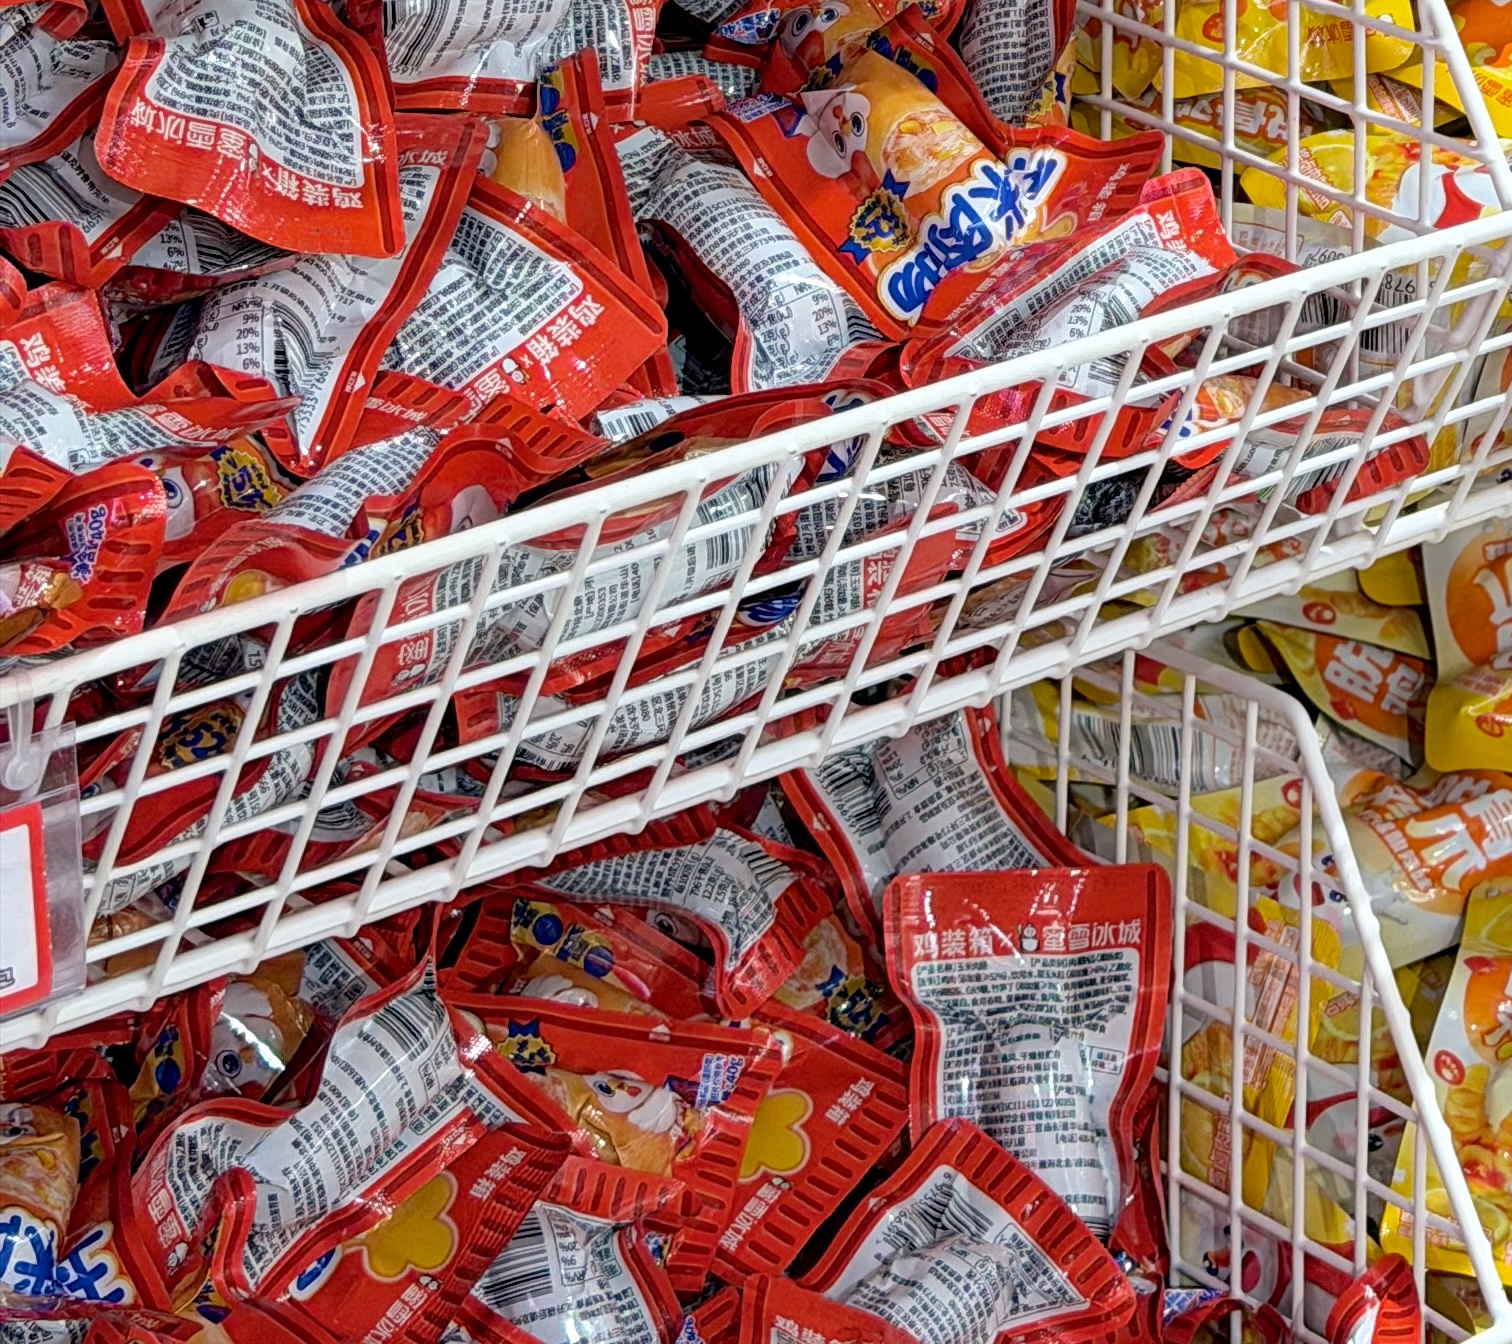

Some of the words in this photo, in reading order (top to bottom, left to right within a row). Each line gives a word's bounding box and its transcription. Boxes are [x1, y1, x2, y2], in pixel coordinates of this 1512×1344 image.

[812, 308, 833, 321] 20%
[1070, 302, 1091, 314] 20%
[817, 320, 837, 334] 13%
[236, 328, 260, 341] 20%
[236, 343, 260, 357] 13%
[242, 358, 261, 371] 6%
[912, 925, 994, 959] 鸡装箱
[1043, 919, 1142, 952] 蜜雪冰城
